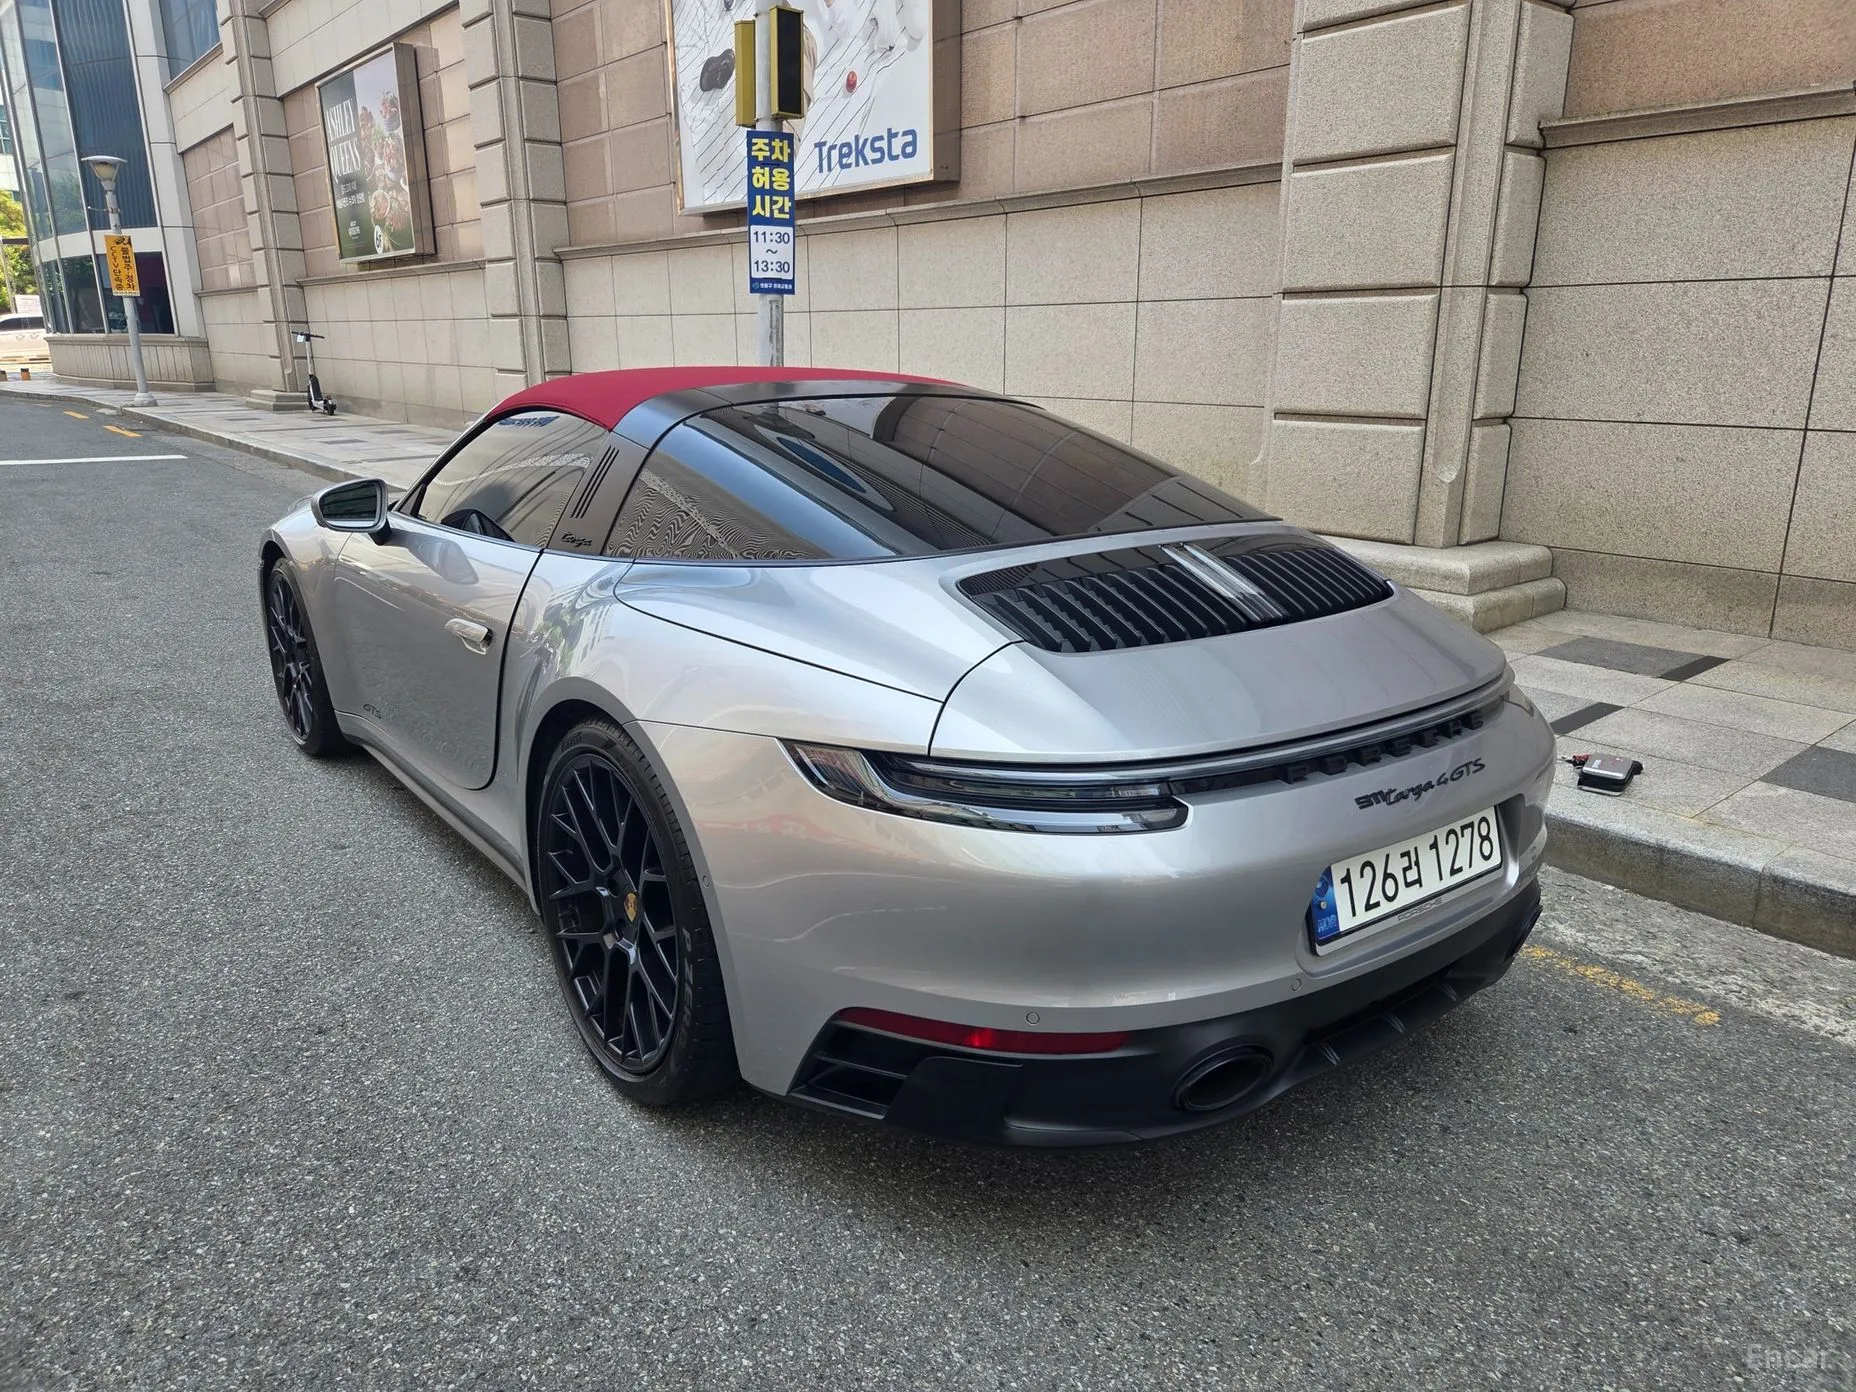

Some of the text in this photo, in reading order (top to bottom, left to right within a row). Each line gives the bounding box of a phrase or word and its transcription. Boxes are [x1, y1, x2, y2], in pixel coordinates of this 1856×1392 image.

[325, 98, 355, 142] ASHLEY
[330, 137, 361, 184] QUEENS
[751, 138, 791, 163] 주차
[814, 128, 918, 174] Treksta
[752, 166, 791, 191] 허용
[752, 195, 792, 219] 시간
[753, 231, 790, 244] 11:30
[753, 260, 790, 273] 13:30
[1436, 772, 1449, 786] 4
[1450, 757, 1486, 782] GTS
[1340, 816, 1494, 917] 126러 1278
